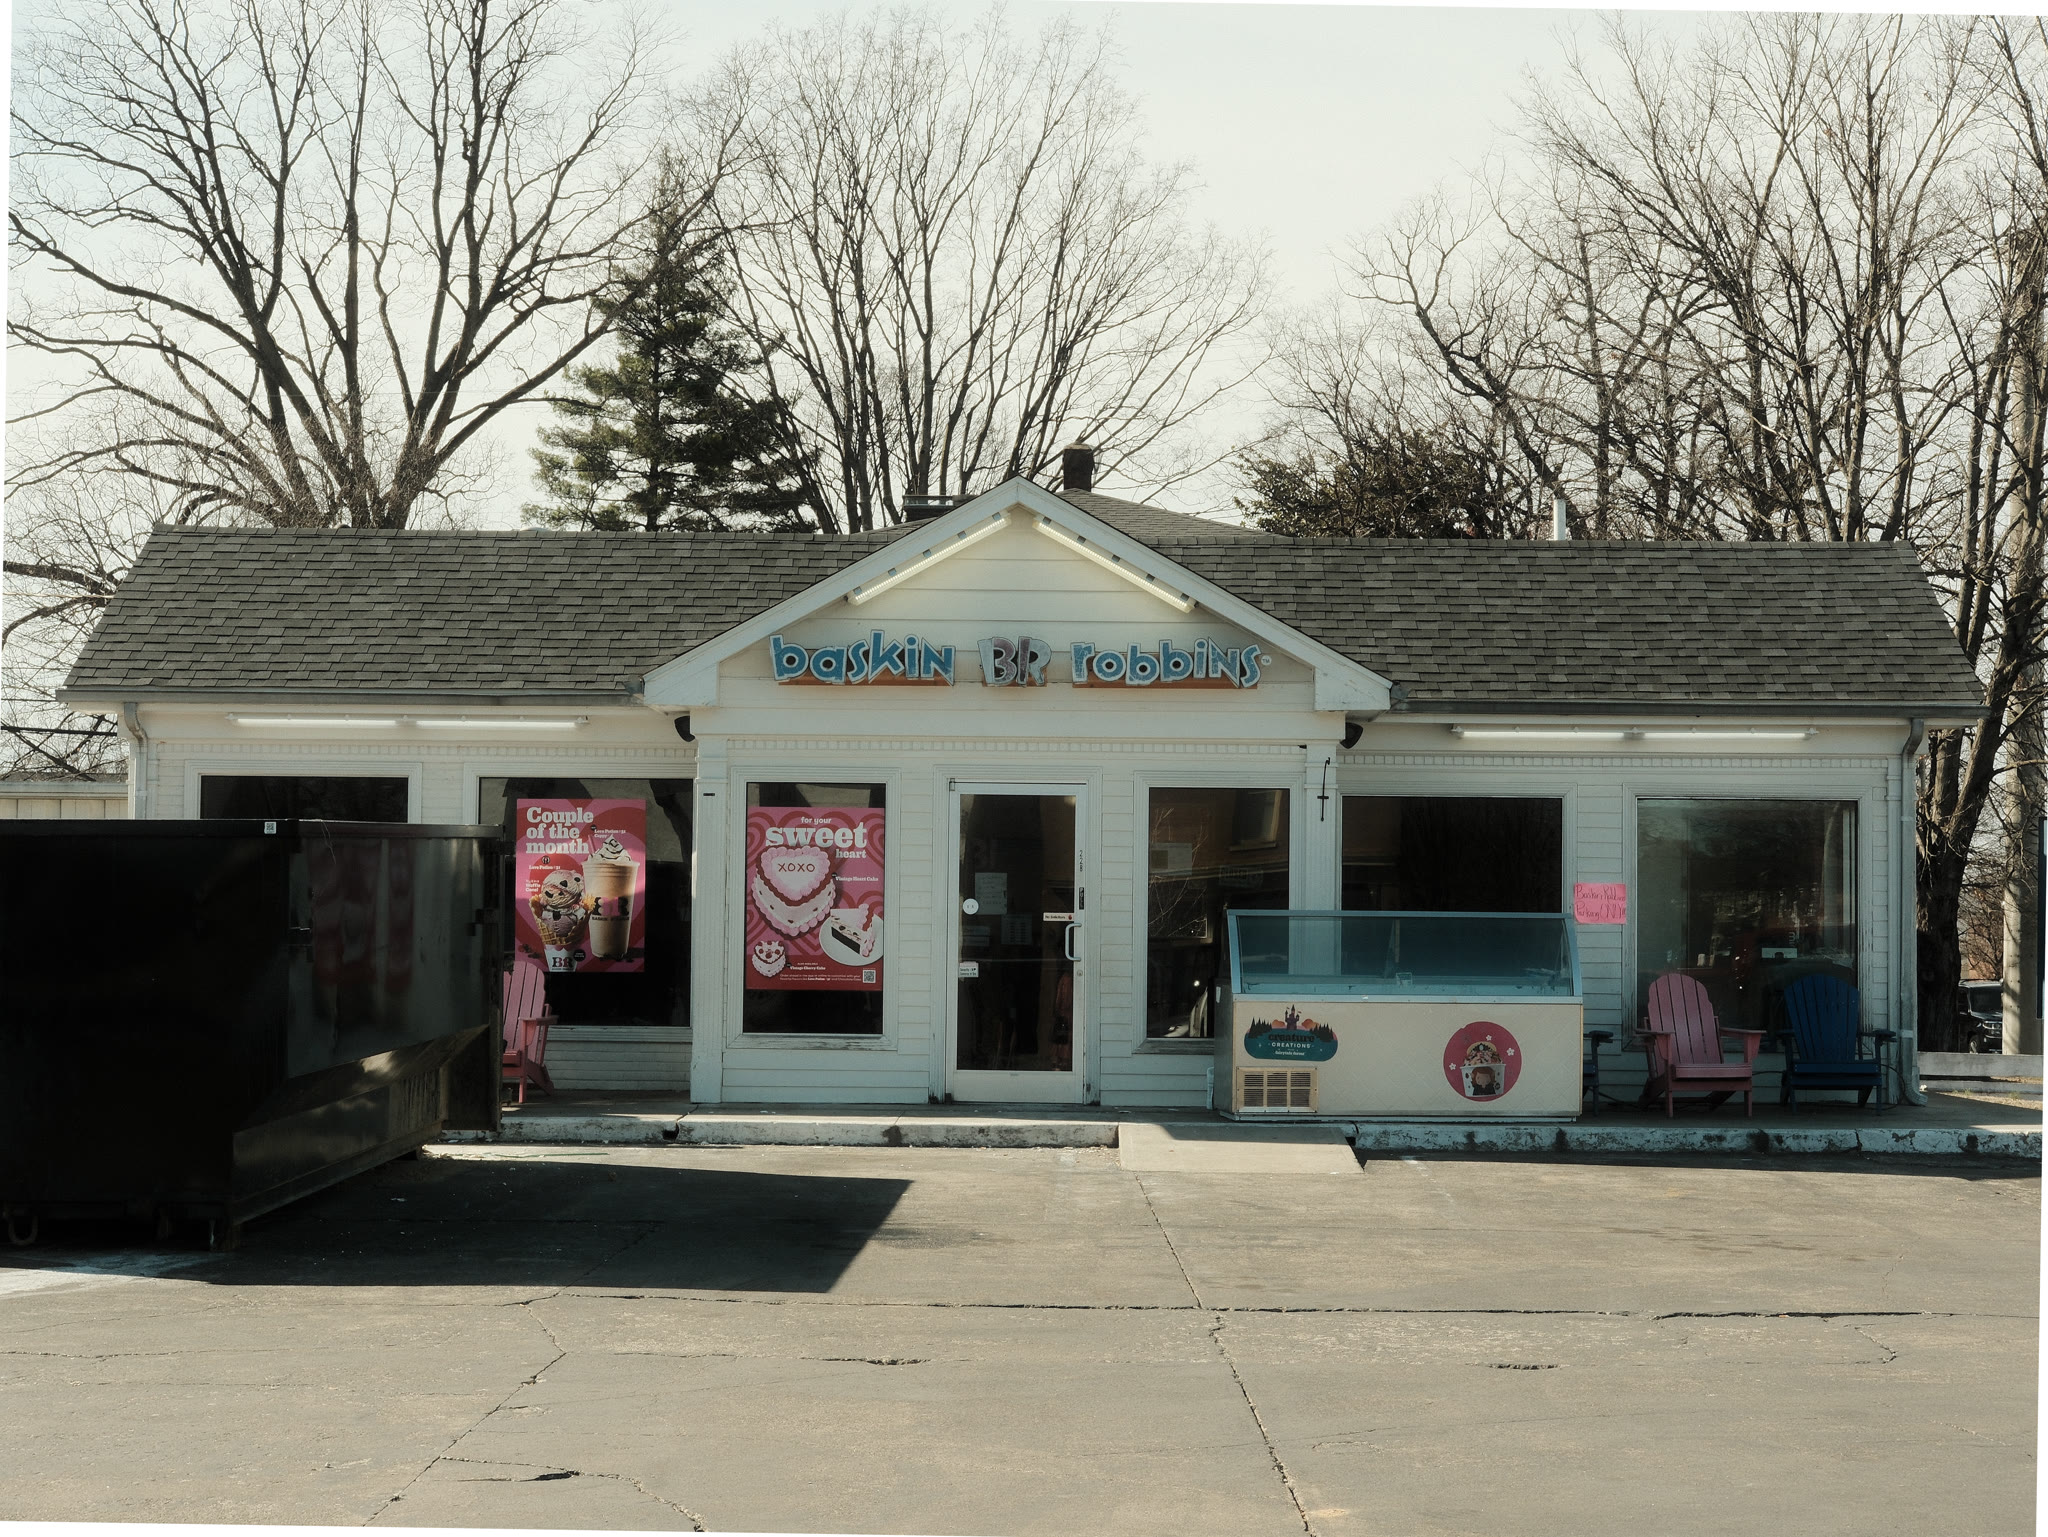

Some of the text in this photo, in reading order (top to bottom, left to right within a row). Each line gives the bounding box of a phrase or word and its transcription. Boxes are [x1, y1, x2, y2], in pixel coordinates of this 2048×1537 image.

[977, 636, 1051, 686] BR
[526, 806, 594, 826] Couple
[526, 823, 580, 839] of the
[765, 821, 868, 849] sweet
[526, 838, 590, 854] month
[835, 848, 867, 859] heart
[778, 862, 816, 873] XOXO
